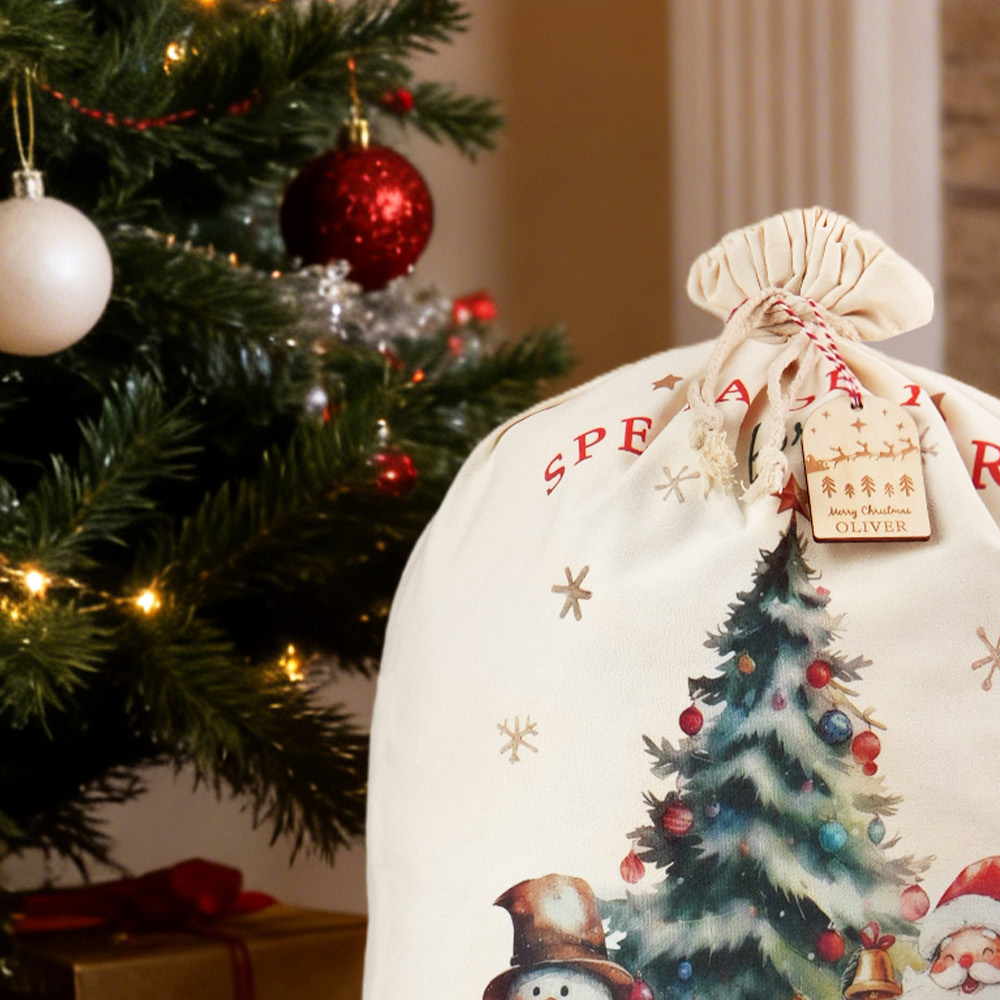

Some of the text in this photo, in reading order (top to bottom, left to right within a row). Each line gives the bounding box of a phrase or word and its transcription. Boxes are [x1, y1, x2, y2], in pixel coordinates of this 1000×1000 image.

[828, 504, 912, 519] Merry Christmas
[835, 520, 909, 534] OLIVER
